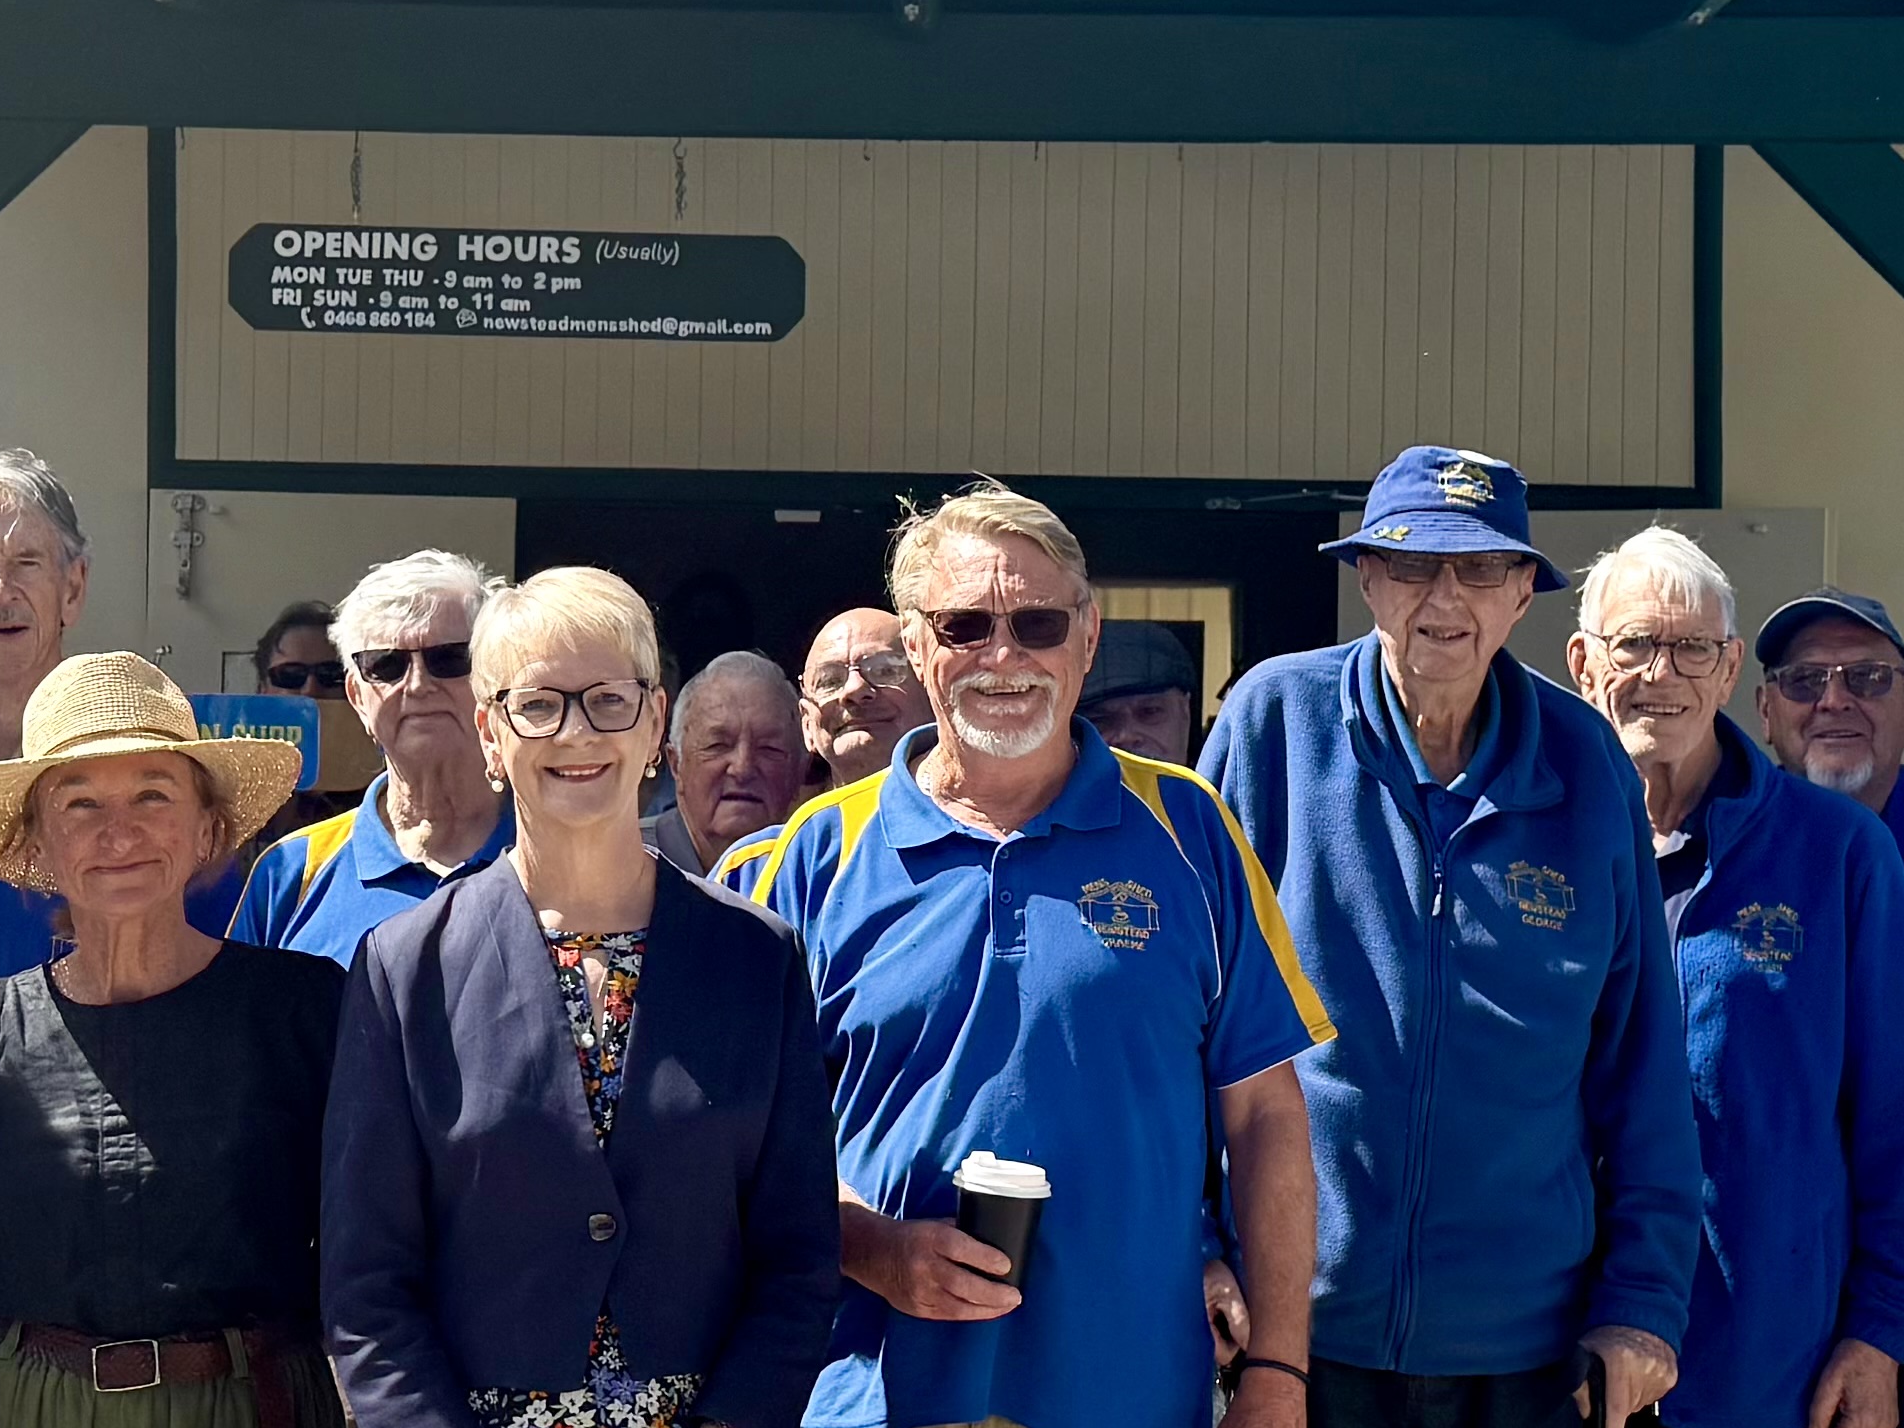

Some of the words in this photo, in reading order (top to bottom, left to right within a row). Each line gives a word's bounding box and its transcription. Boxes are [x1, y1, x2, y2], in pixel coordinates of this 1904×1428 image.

[273, 229, 439, 262] OPENING
[458, 235, 581, 264] HOURS
[595, 237, 680, 266] (Usually)
[271, 266, 325, 285] MON
[336, 267, 372, 286] TUE
[382, 269, 424, 287] THU
[444, 270, 457, 289] 9
[462, 274, 493, 290] am
[501, 272, 523, 290] to
[533, 272, 547, 290] 2
[551, 275, 582, 294] pm
[272, 287, 302, 306] FRI
[313, 288, 357, 307] SUN
[379, 290, 393, 308] 9
[398, 295, 429, 309] am
[438, 293, 459, 310] to
[472, 293, 494, 311] 11
[500, 297, 531, 312] am
[483, 315, 773, 337] newsteadmensshed@gmail.com
